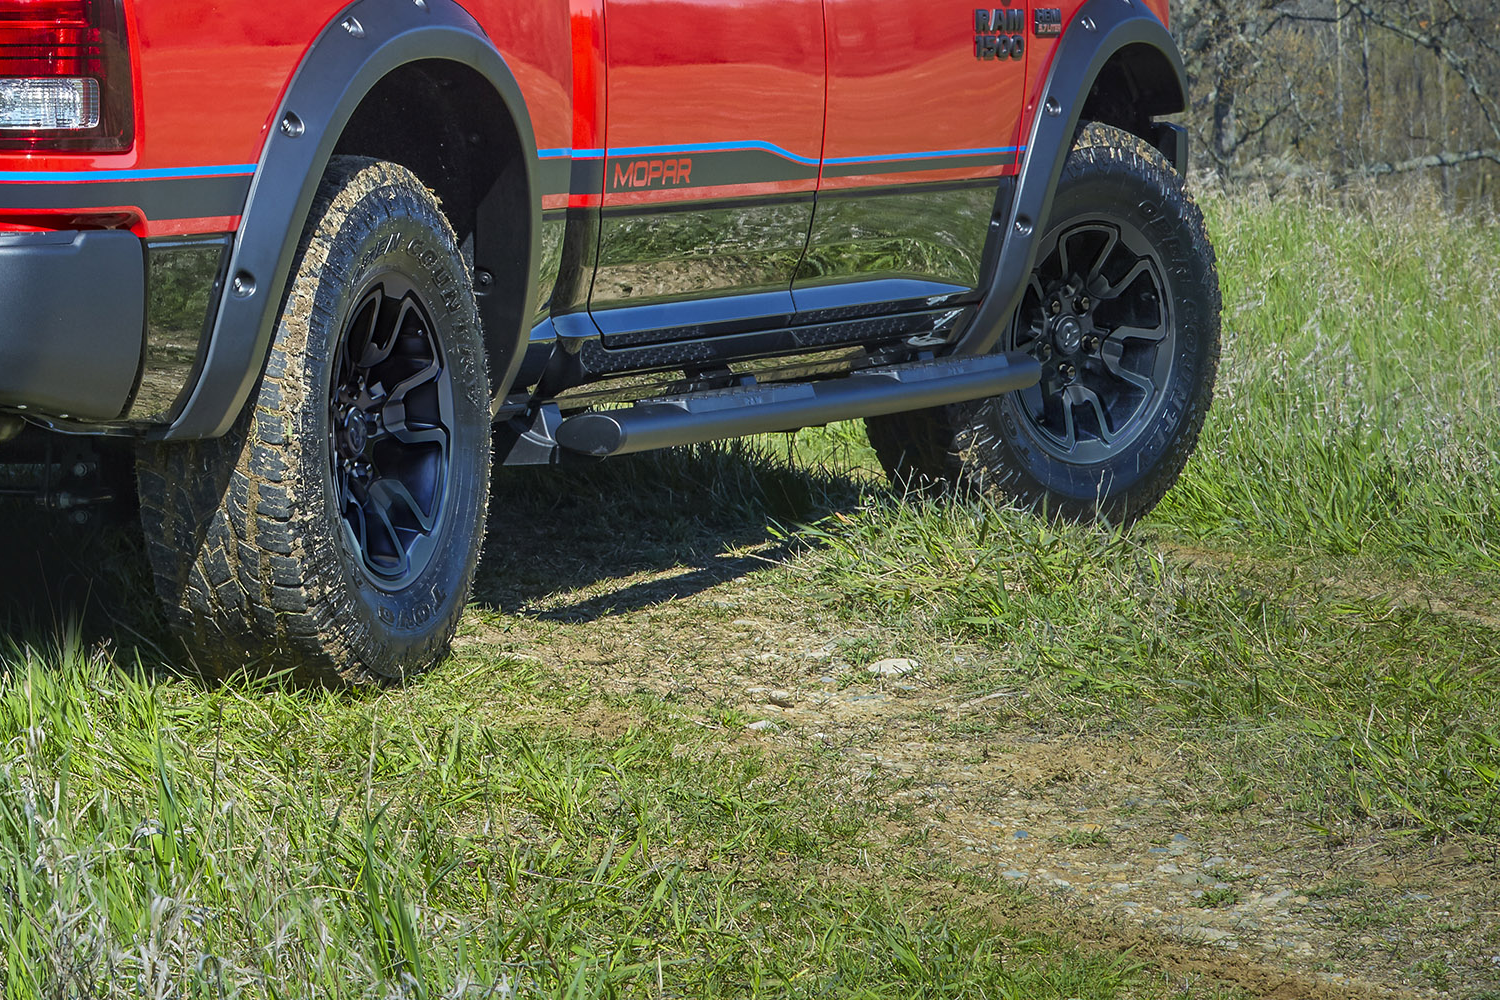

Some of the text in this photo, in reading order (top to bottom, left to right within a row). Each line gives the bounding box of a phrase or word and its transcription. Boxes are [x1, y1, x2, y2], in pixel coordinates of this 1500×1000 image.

[973, 8, 1025, 34] RAM
[974, 34, 1025, 61] 1500
[613, 158, 692, 189] MOPAR
